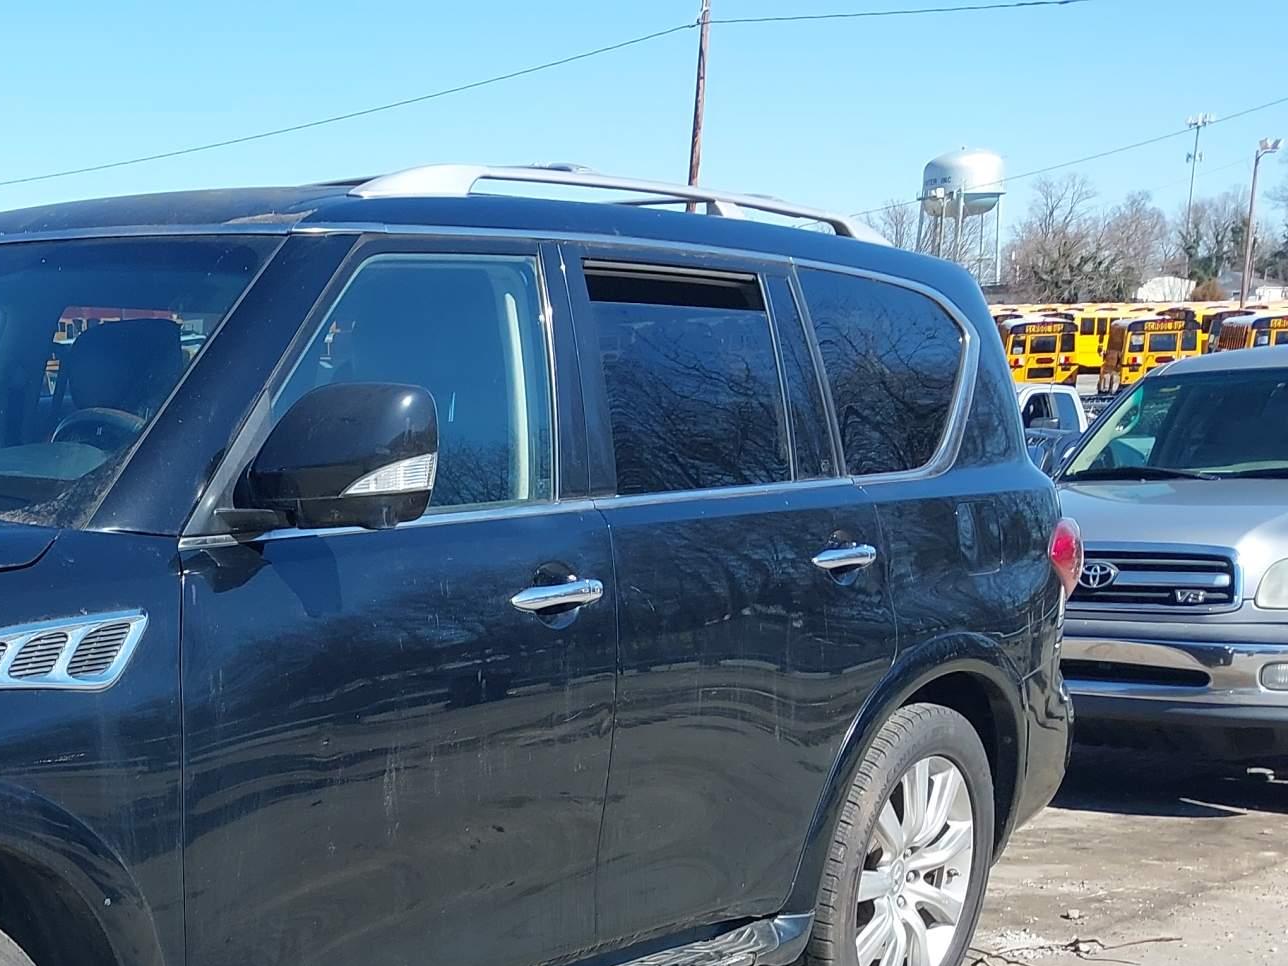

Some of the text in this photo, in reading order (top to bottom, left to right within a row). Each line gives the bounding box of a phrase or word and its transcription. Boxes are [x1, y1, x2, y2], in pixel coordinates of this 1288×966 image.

[1025, 324, 1052, 333] SCHOOL
[1144, 321, 1173, 331] SCHOOL
[1175, 590, 1207, 603] V8
